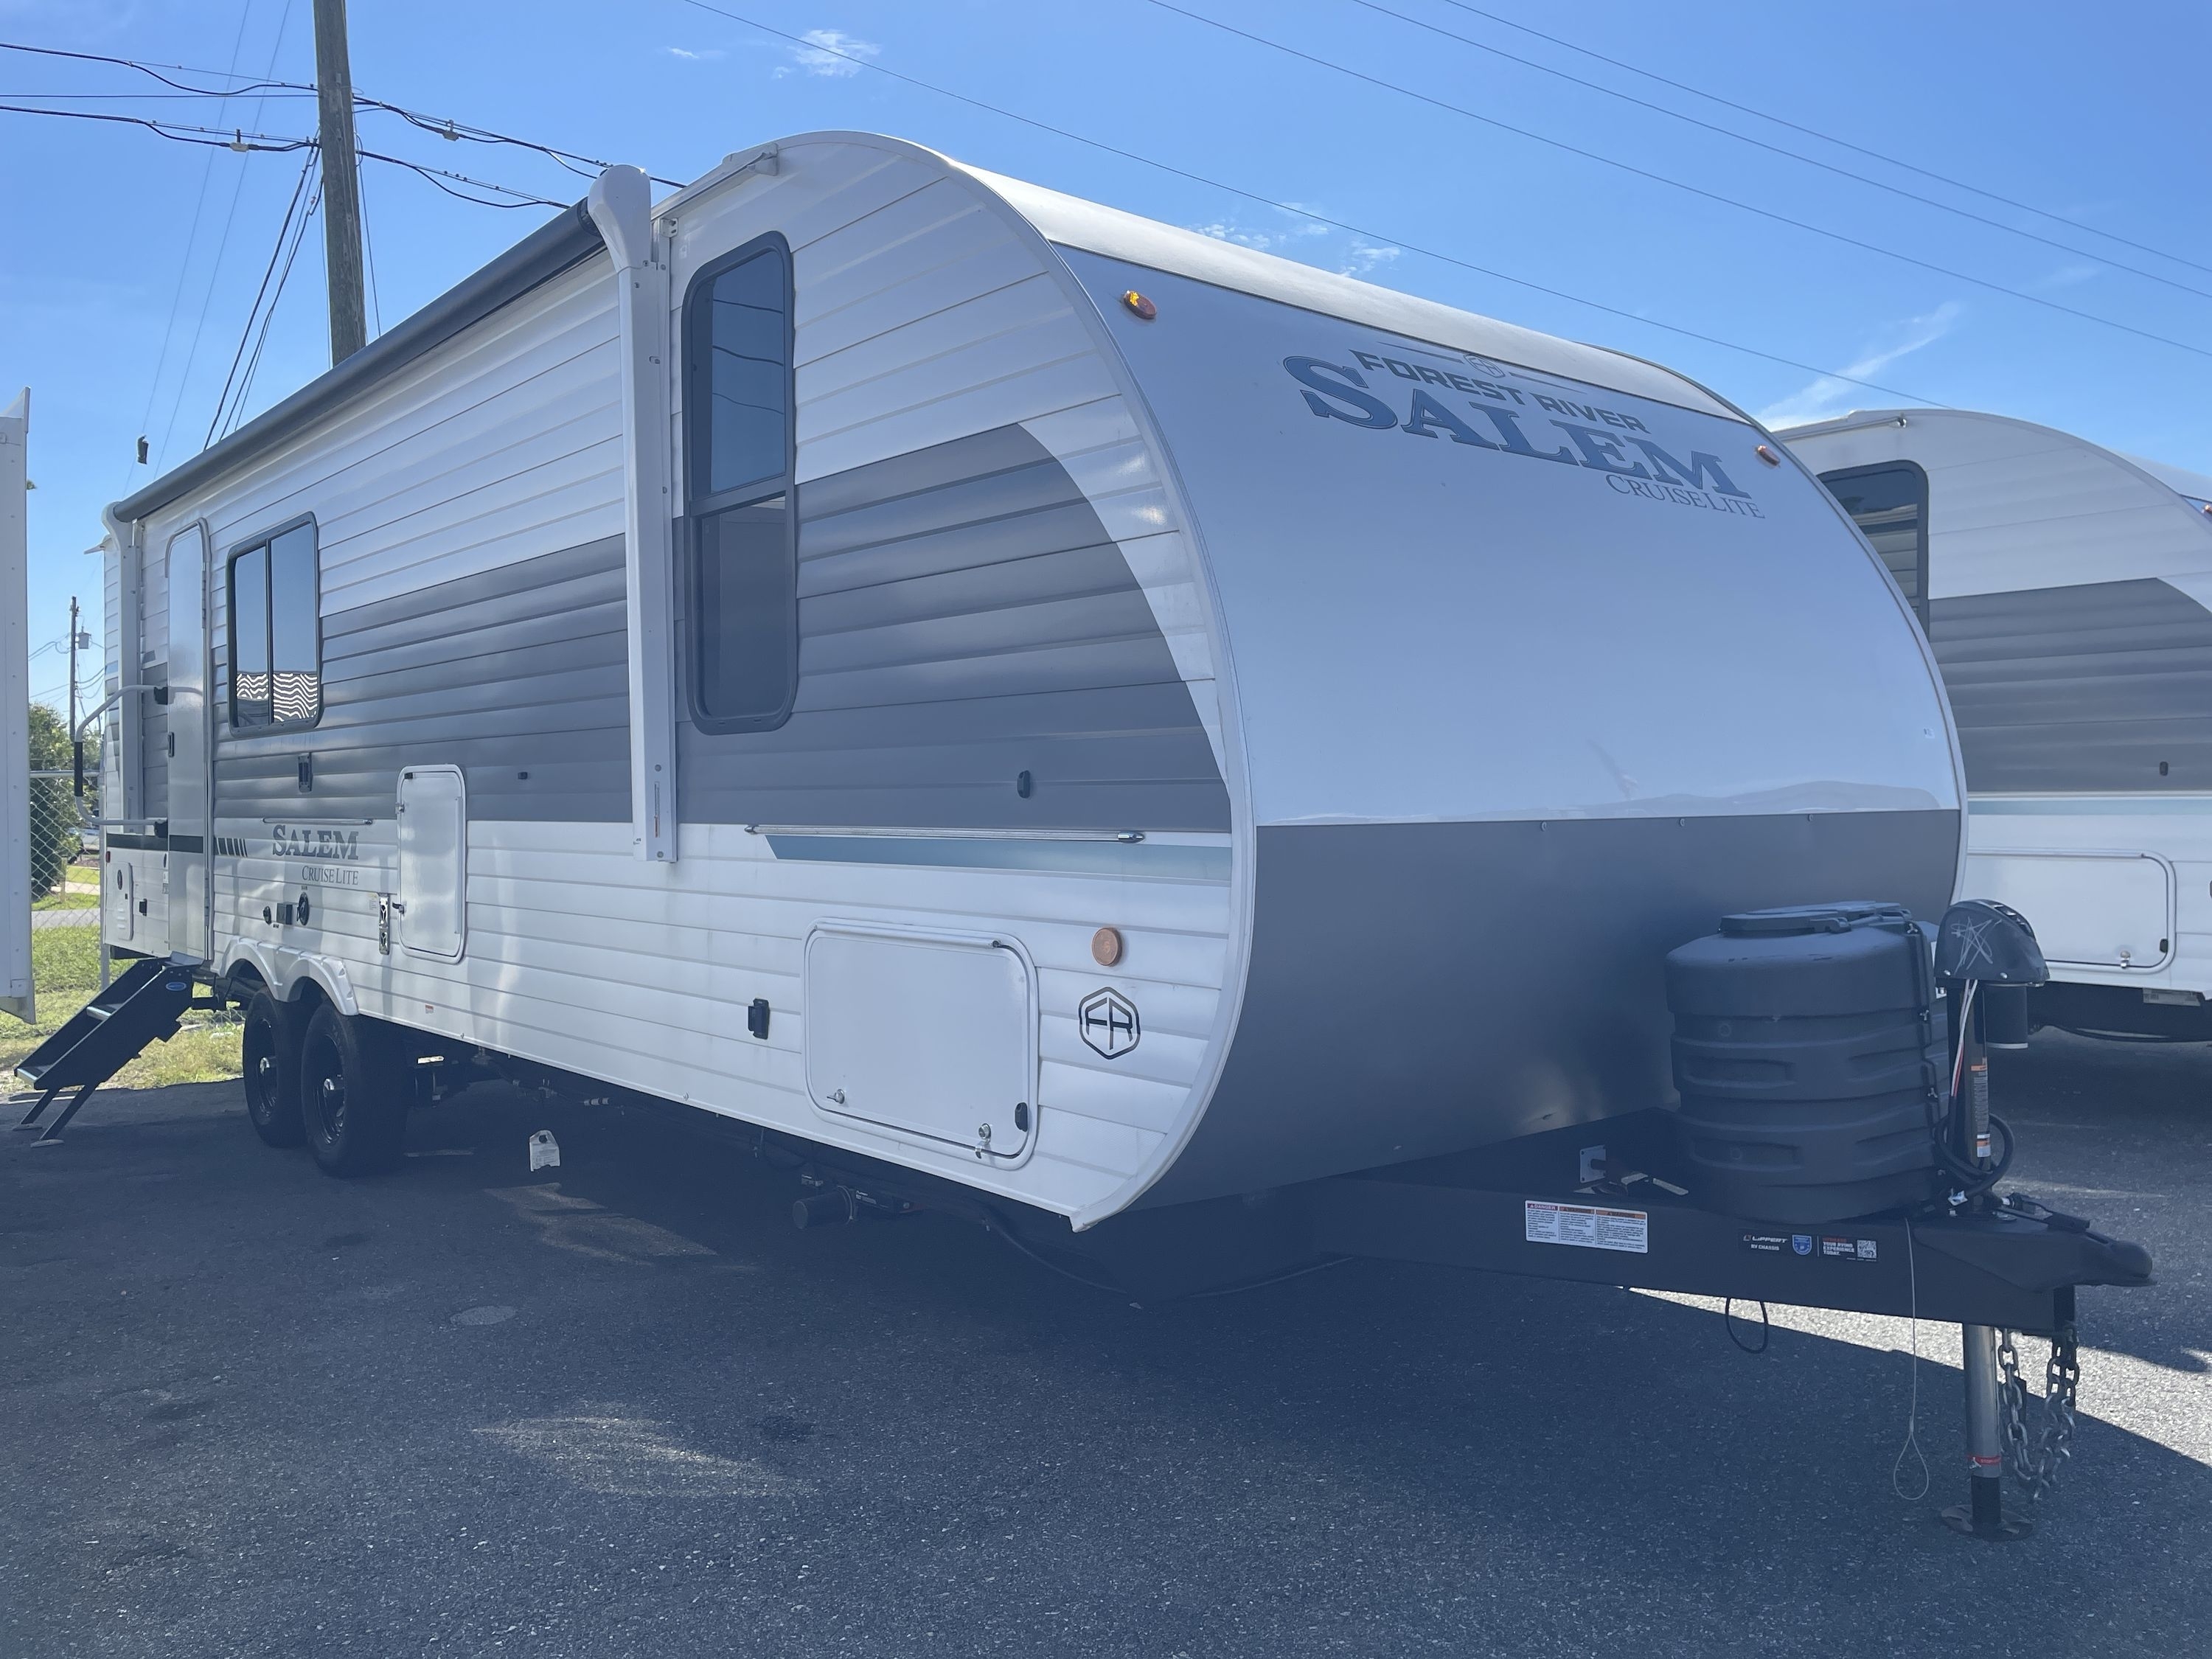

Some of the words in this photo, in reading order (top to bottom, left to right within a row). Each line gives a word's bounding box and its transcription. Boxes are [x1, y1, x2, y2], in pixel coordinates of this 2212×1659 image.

[1283, 355, 1752, 499] SALEM
[1349, 349, 1525, 406] FOREST
[1528, 392, 1652, 434] RIVER
[272, 824, 359, 860] SALEM
